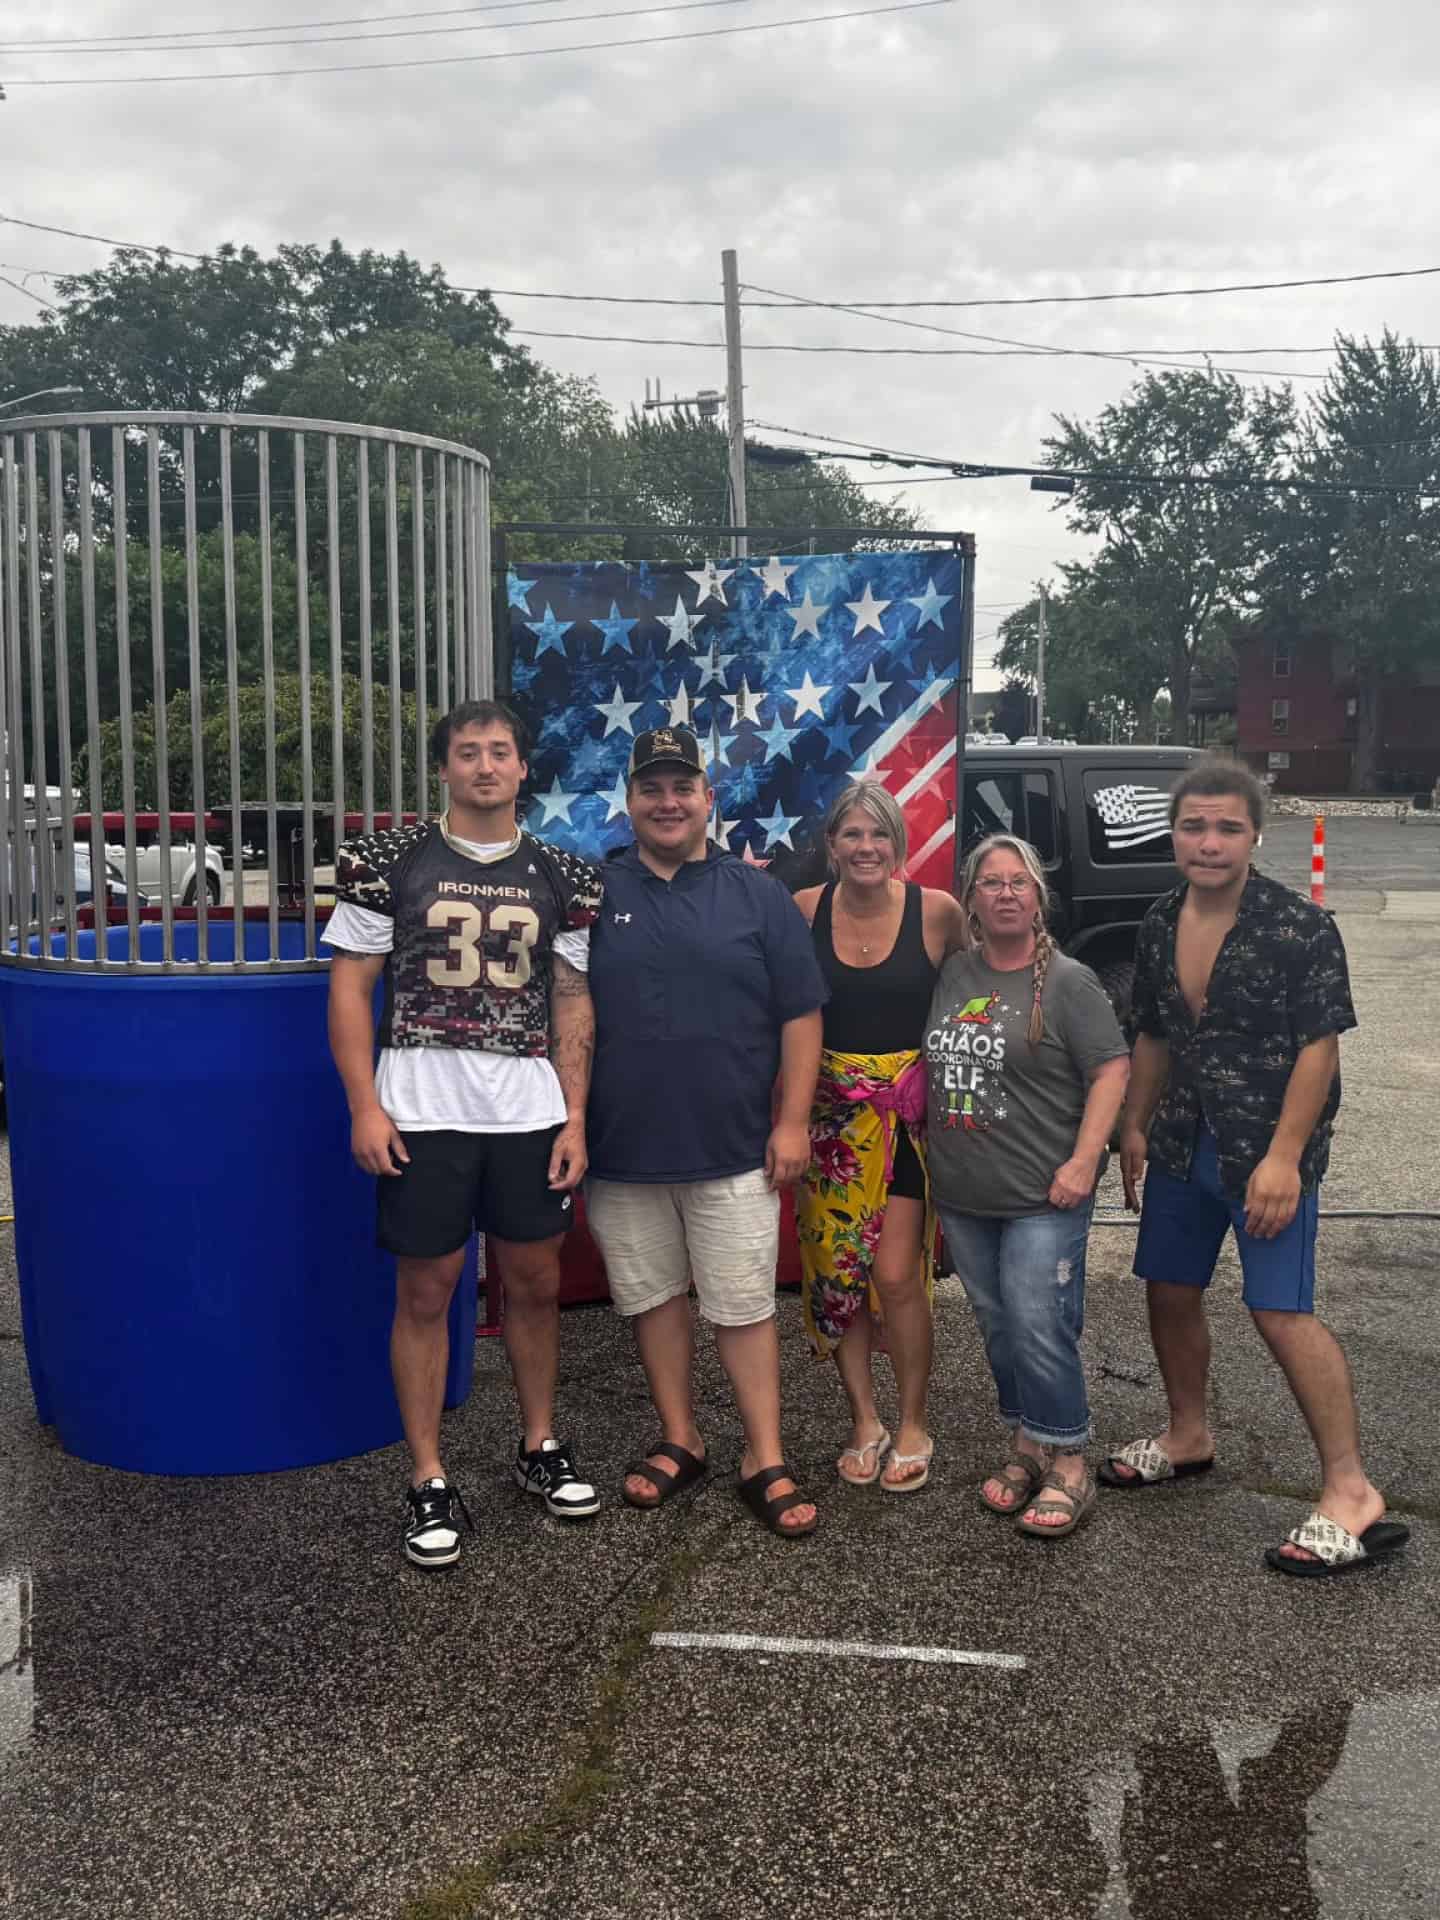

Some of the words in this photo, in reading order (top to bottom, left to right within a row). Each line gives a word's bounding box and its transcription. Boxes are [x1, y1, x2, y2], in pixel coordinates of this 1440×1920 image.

[438, 881, 530, 899] IRONMEN
[426, 900, 539, 988] 33
[960, 1023, 978, 1035] THE
[927, 1029, 1006, 1060] CHAOS
[927, 1051, 1004, 1072] COORDINATOR
[944, 1064, 985, 1091] ELF
